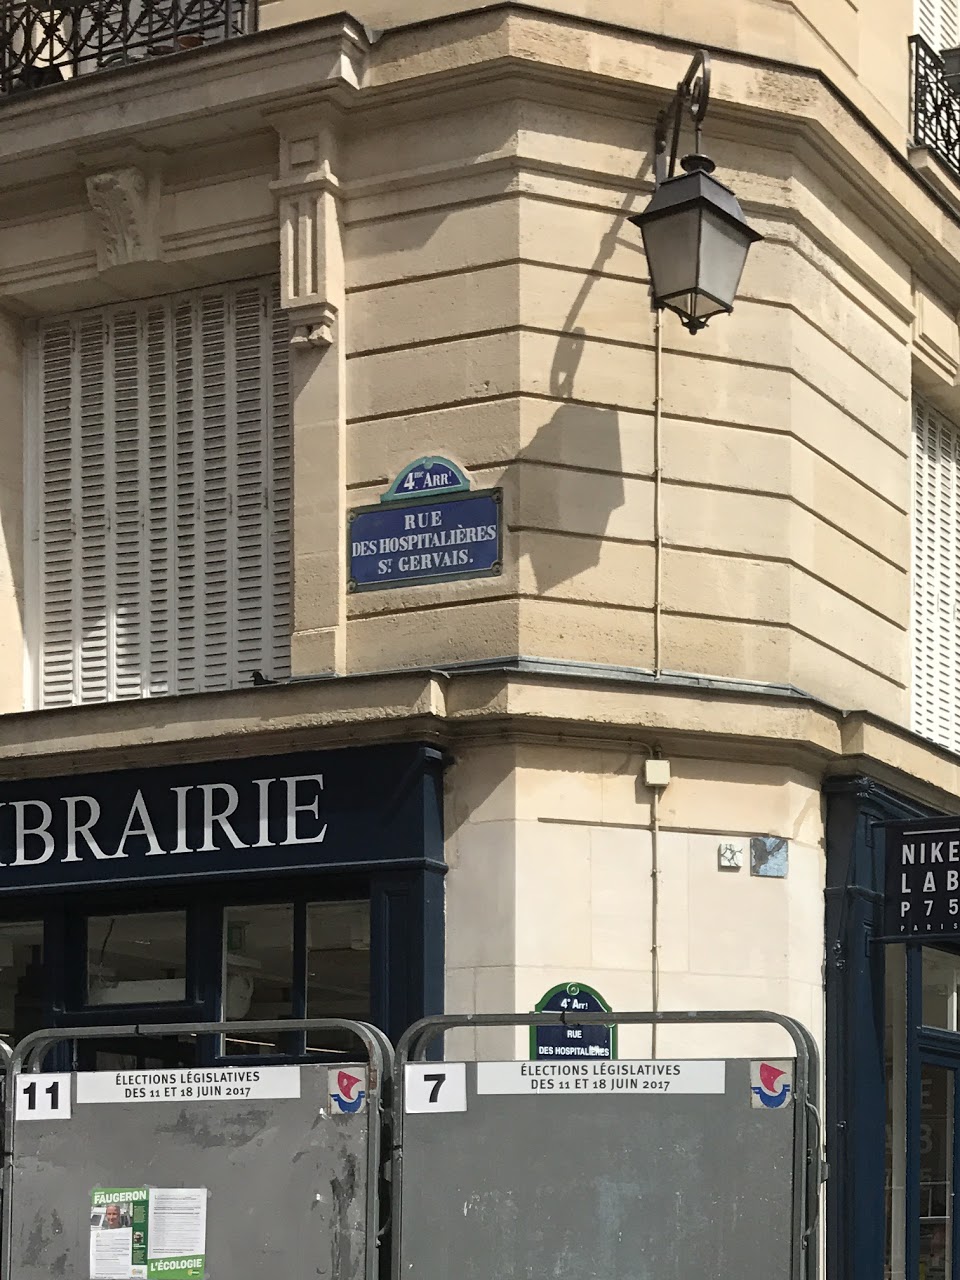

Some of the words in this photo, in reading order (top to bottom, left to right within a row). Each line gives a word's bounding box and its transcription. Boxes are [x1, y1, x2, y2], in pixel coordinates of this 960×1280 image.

[404, 510, 442, 530] RUE
[352, 540, 377, 557] DES
[379, 524, 497, 553] HOSPITALIÈRES
[398, 549, 474, 572] GERVAIS.
[902, 840, 960, 865] NIKE
[901, 870, 959, 894] LAB
[900, 922, 958, 932] PARIS
[566, 1029, 582, 1039] RUE
[538, 1046, 554, 1055] DES
[520, 1063, 589, 1076] ÉLECTIONS
[593, 1062, 681, 1076] LÉGISLATIVES
[115, 1073, 177, 1086] ÉLECTIONS
[180, 1071, 260, 1084] LÉGISLATIVES
[531, 1079, 555, 1090] DES
[558, 1081, 570, 1090] 11
[575, 1078, 589, 1089] ET
[592, 1079, 607, 1089] 18
[610, 1078, 638, 1091] JUIN
[642, 1080, 671, 1091] 2017
[23, 1081, 59, 1110] 11
[125, 1087, 146, 1098] DES
[149, 1089, 161, 1098] 11
[164, 1087, 178, 1097] ET
[180, 1086, 193, 1097] 18
[196, 1086, 222, 1098] JUIN
[225, 1087, 251, 1097] 2017
[423, 1073, 447, 1103] 7
[94, 1190, 147, 1205] FAUGERON
[150, 1258, 203, 1272] L'ÉCOLOGIE
